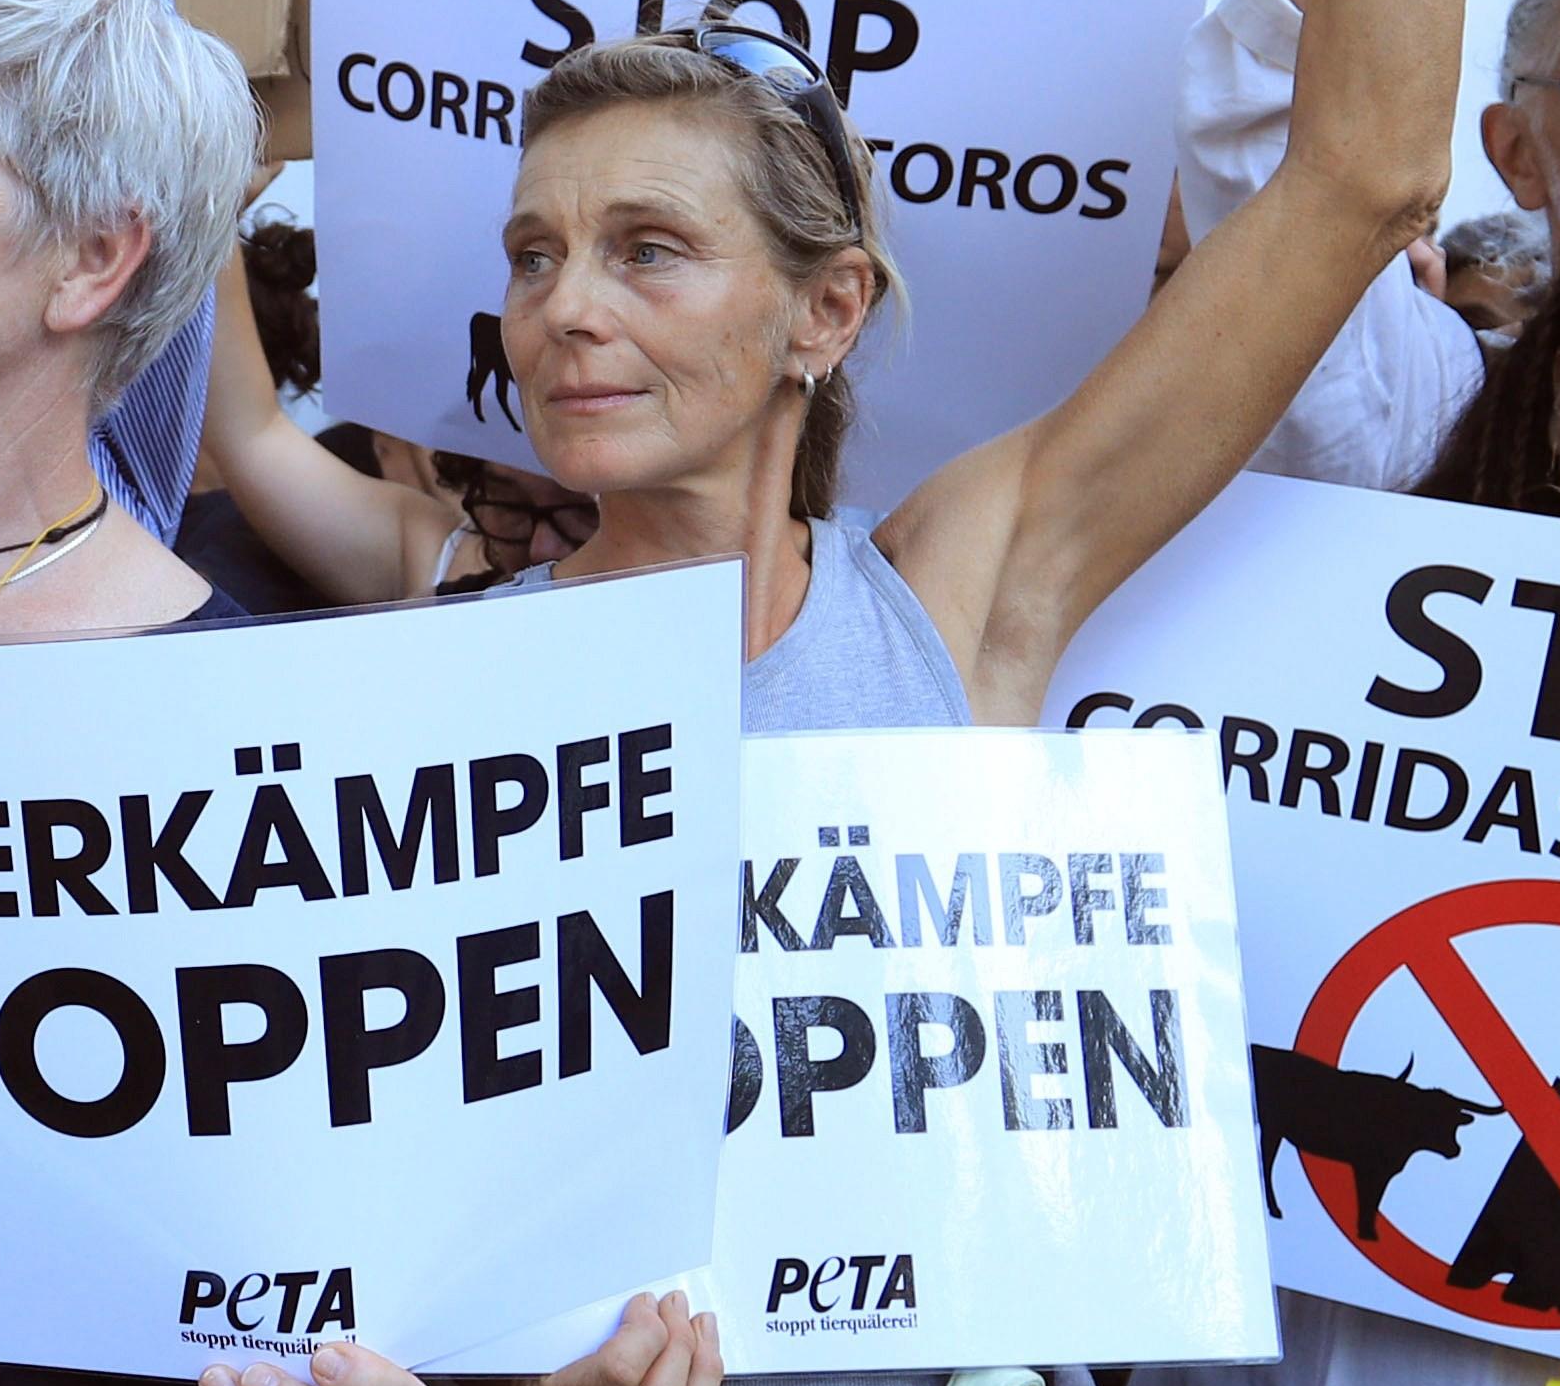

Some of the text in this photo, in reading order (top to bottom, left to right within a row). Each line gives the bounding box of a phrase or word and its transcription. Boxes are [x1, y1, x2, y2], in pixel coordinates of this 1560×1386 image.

[337, 51, 525, 149] CORR
[737, 823, 1176, 955] KÄMPFE
[178, 1266, 356, 1334] PeTA
[765, 1253, 917, 1315] PeTA
[180, 1329, 357, 1358] stoppt tierquäl
[765, 1313, 919, 1338] stoppt tierquälerei!
